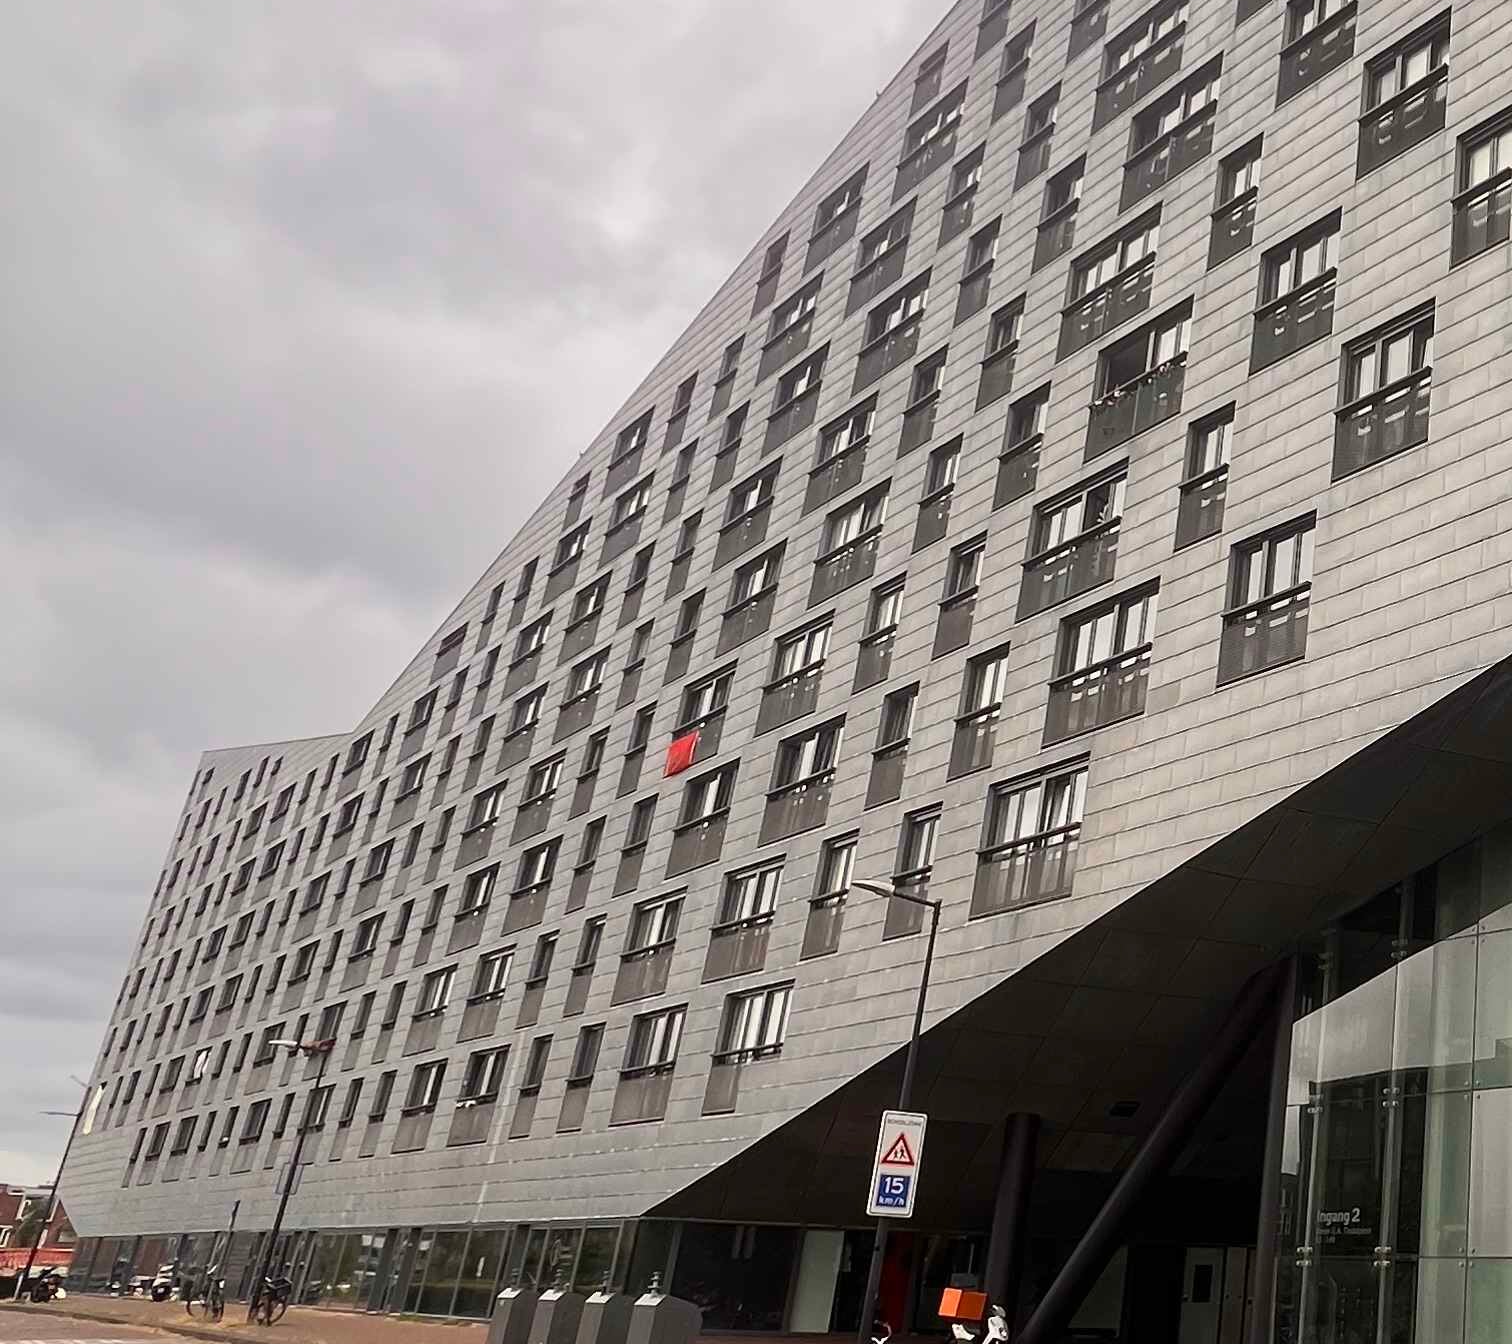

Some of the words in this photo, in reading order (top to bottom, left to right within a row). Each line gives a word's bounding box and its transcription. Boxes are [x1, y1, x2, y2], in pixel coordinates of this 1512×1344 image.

[884, 1176, 904, 1194] 15
[879, 1196, 905, 1206] km/h
[1317, 1209, 1350, 1225] Ingang
[1351, 1207, 1360, 1222] 2
